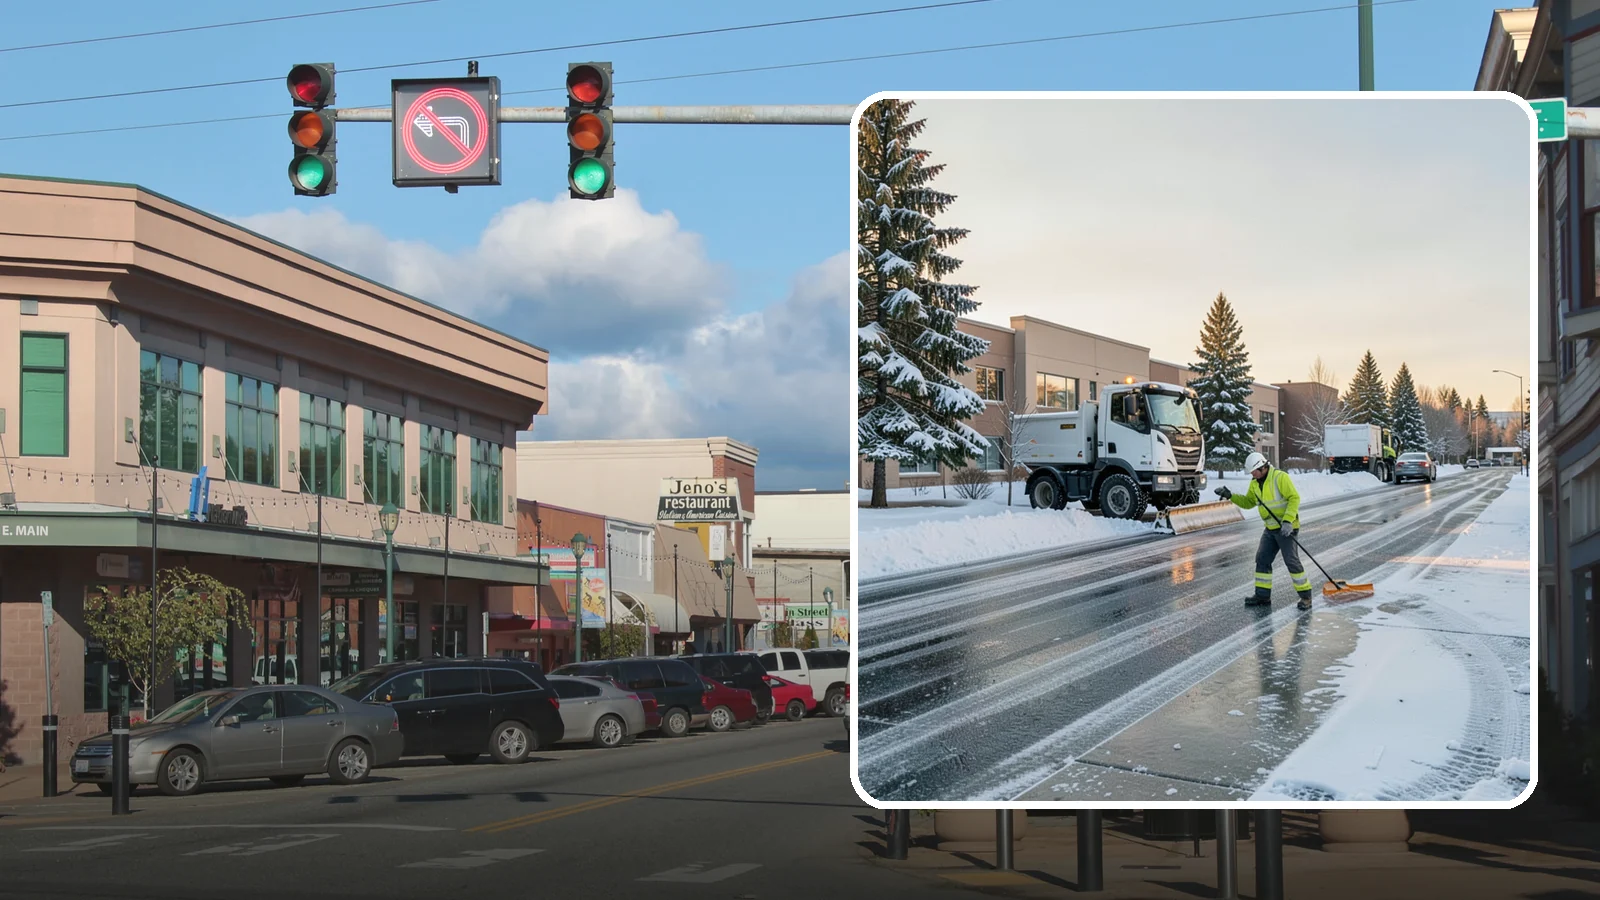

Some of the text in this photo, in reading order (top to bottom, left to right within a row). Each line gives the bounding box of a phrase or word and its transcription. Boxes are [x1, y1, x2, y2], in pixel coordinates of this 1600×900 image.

[670, 479, 728, 494] Jeno's
[665, 496, 731, 509] restaurant
[659, 510, 682, 520] Italian
[686, 510, 714, 520] American
[715, 509, 737, 519] Cuisine
[2, 525, 49, 536] E. MAIN
[797, 607, 828, 616] Street
